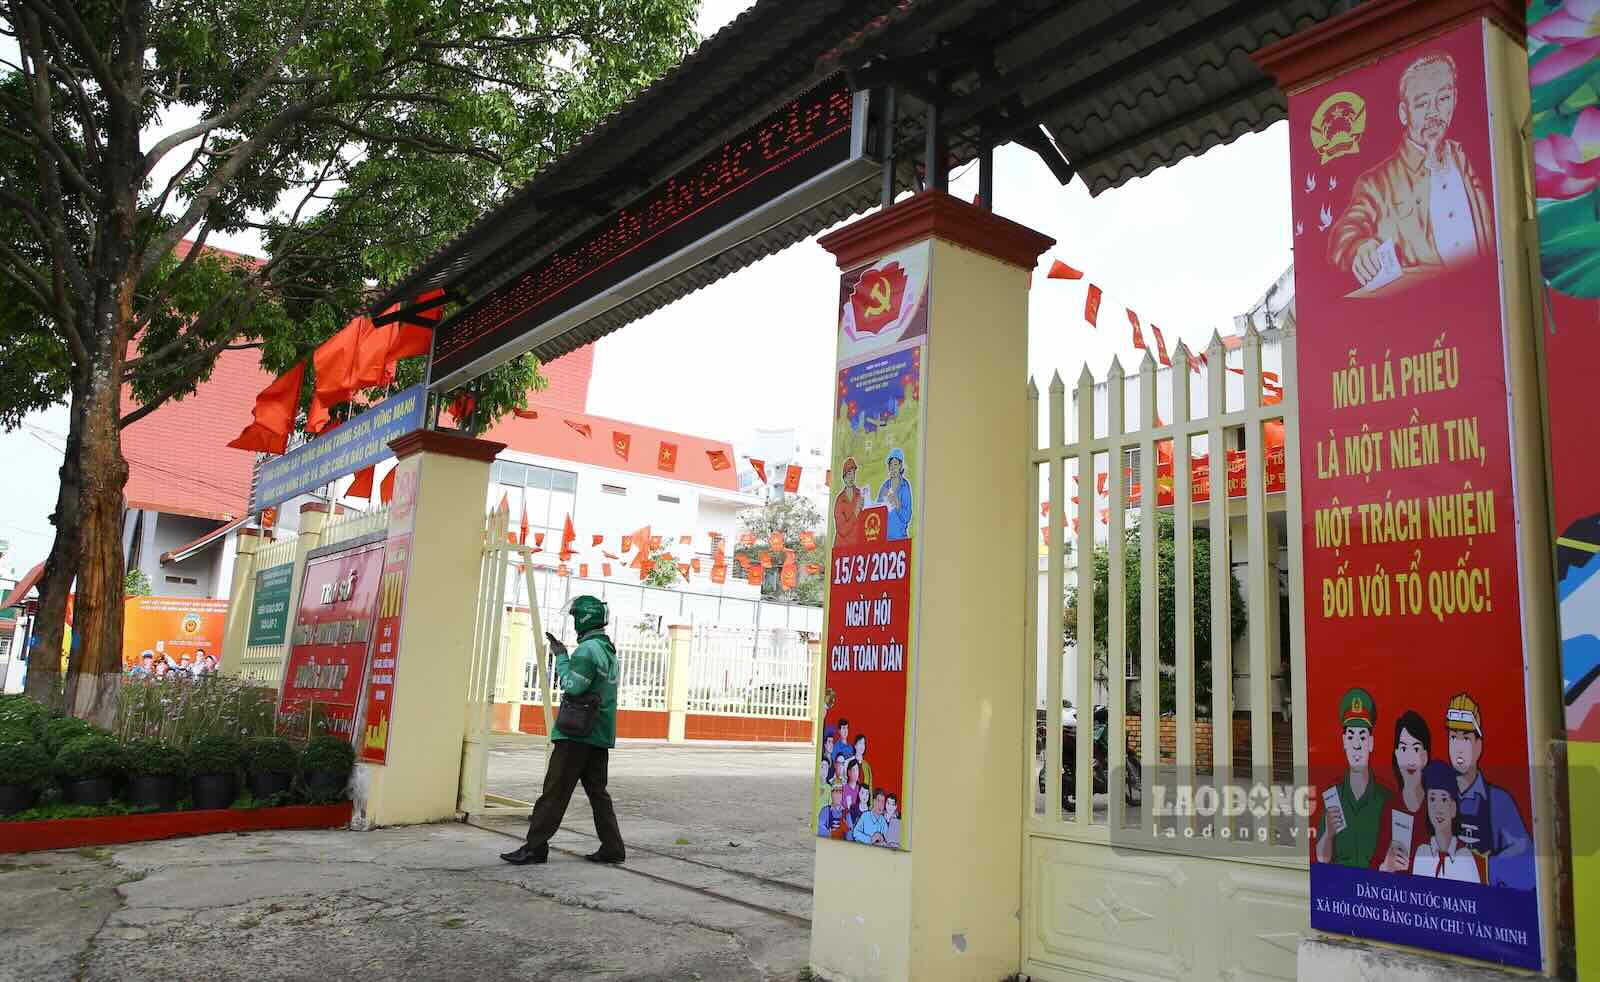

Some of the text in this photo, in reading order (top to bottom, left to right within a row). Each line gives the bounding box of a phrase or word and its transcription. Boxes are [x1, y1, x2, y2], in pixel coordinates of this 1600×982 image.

[700, 143, 752, 198] CÁC
[1332, 332, 1459, 409] MỖI LÁ PHIẾU
[1317, 429, 1340, 479] LÀ
[1344, 423, 1383, 483] MỘT
[1389, 407, 1440, 469] NIỀM
[1444, 416, 1486, 468] TIN,
[1315, 480, 1496, 557] MỘT TRÁCH NHIỆM
[834, 550, 906, 585] 15/3/2026
[1322, 549, 1493, 622] ĐỐI VỚI TỔ QUỐC!
[845, 591, 893, 632] NGÀY HỘI
[832, 635, 903, 671] CỦA TOÀN DÂN
[1332, 900, 1350, 917] HỘI
[1494, 928, 1527, 945] MINH
[1442, 896, 1477, 914] MẠNH
